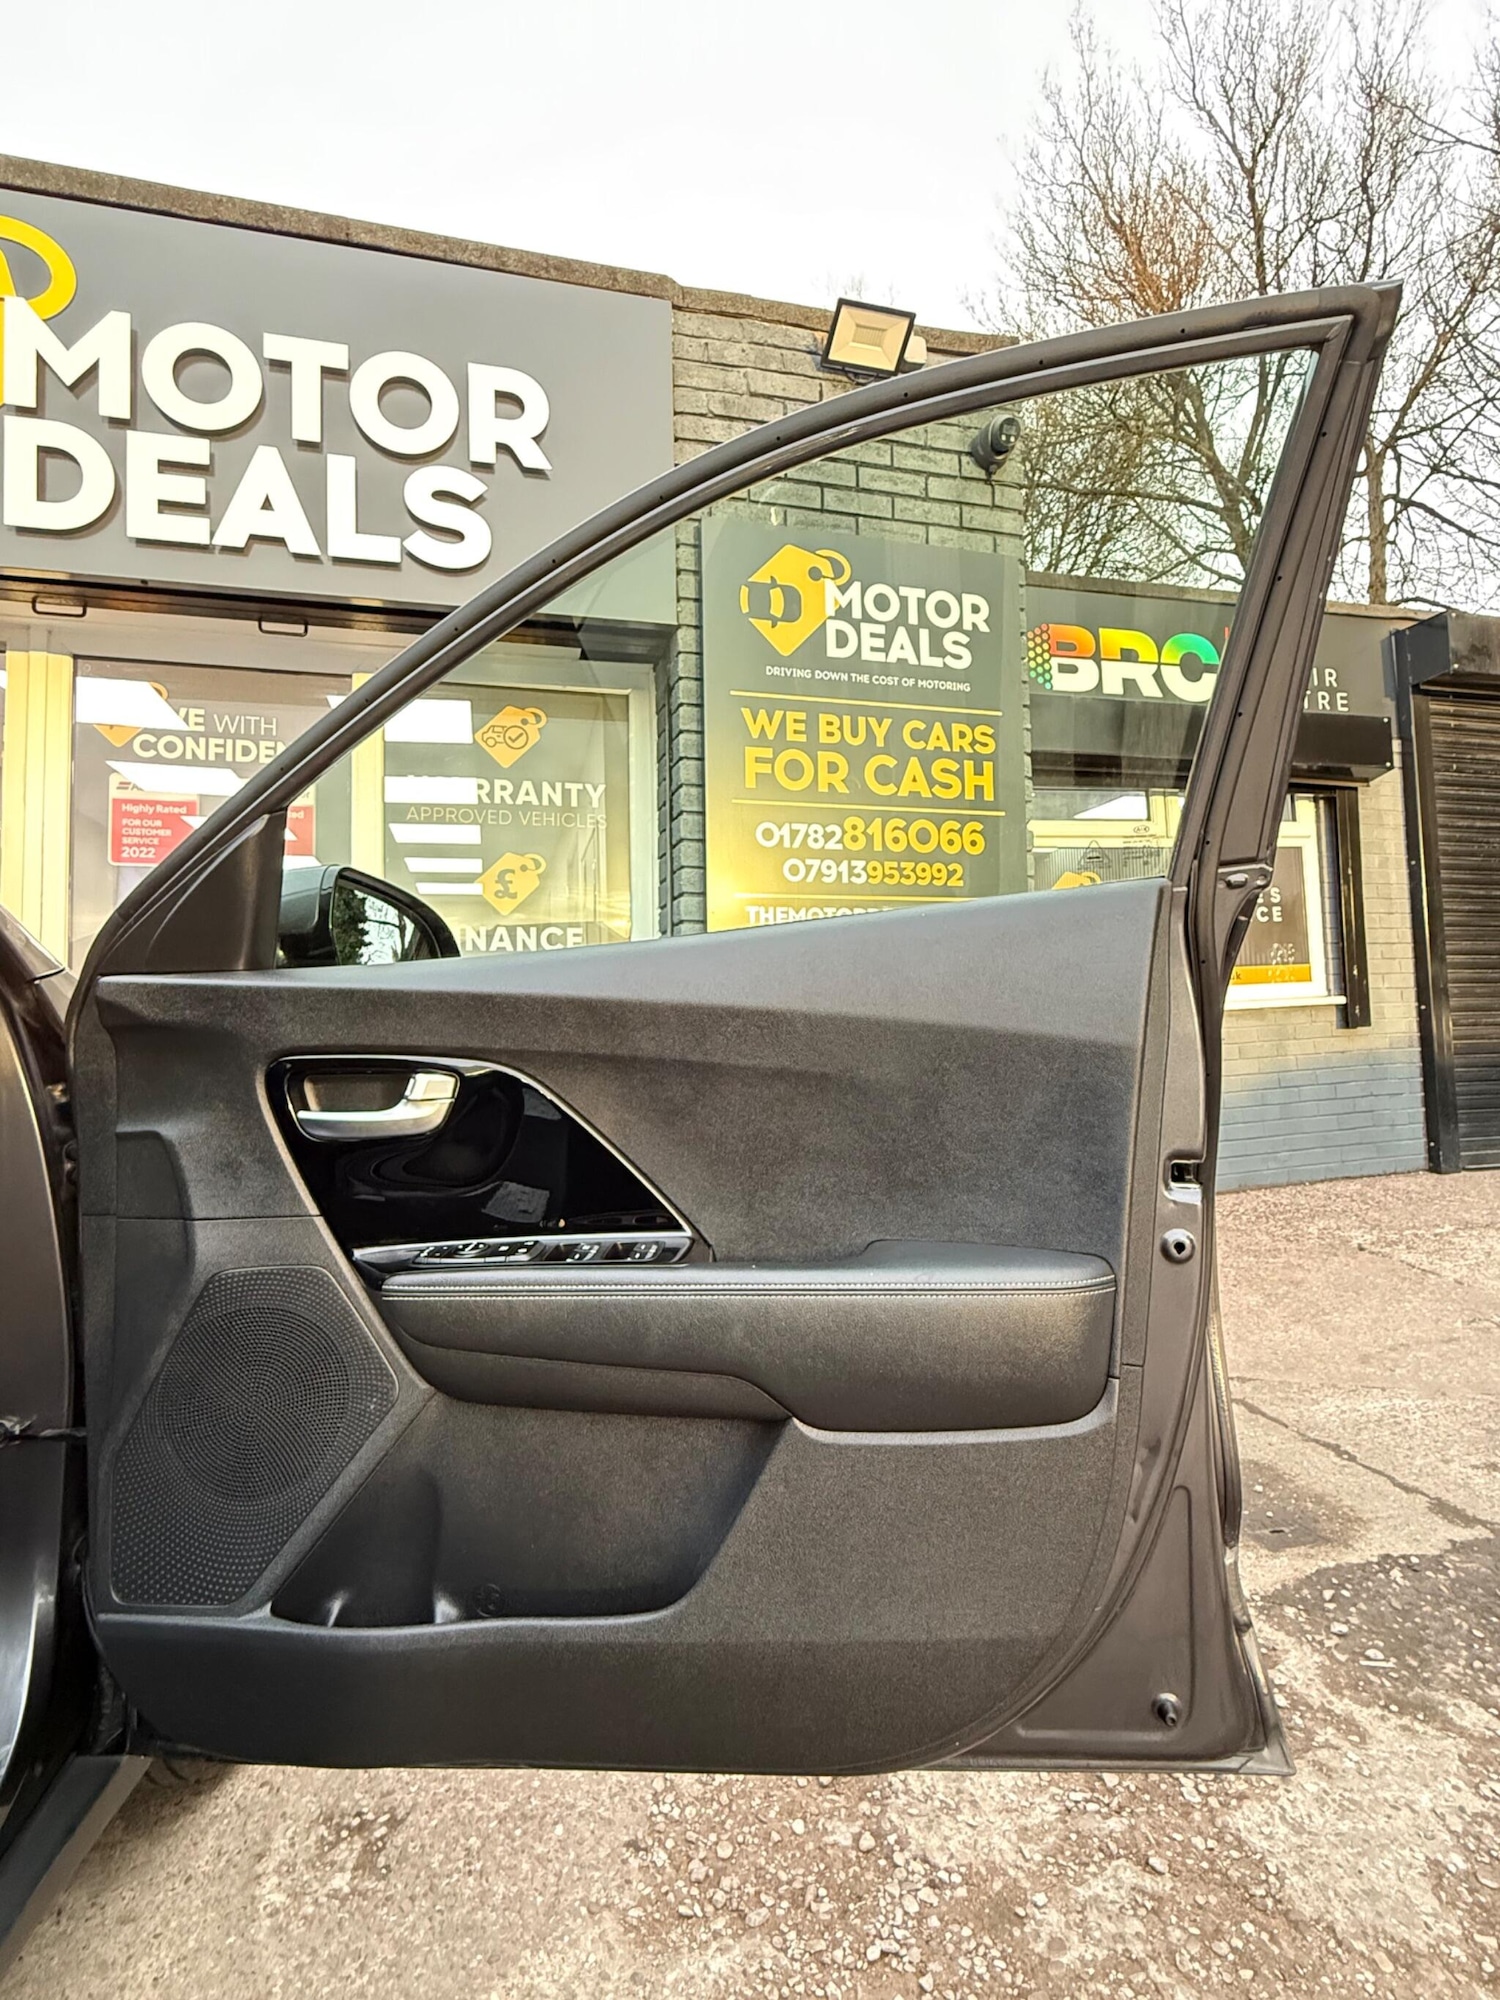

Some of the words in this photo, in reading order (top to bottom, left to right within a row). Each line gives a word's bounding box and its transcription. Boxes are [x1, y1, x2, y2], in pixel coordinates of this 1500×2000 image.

[3, 296, 552, 471] MOTOR
[3, 415, 493, 571] DEALS
[824, 578, 990, 633] MOTOR
[825, 619, 973, 670] DEALS
[765, 665, 812, 679] DRIVING
[814, 669, 849, 682] DOWN
[850, 673, 870, 684] THE
[872, 675, 899, 687] COST
[901, 678, 916, 688] OF
[917, 679, 971, 693] MOTORING
[1312, 667, 1338, 688] IR
[1303, 690, 1349, 712] TRE
[213, 714, 277, 736] WITH
[741, 708, 807, 743] WE
[818, 713, 893, 747] BUY
[902, 719, 997, 755] CARS
[744, 746, 850, 794] FOR
[863, 754, 995, 802] CASH
[121, 803, 154, 814] Highly
[155, 804, 187, 815] Rated
[406, 806, 513, 826] APPROVED
[518, 810, 608, 830] VEHICLES
[121, 818, 140, 828] FOR
[141, 819, 162, 828] OUR
[121, 828, 172, 837] CUSTOMER
[755, 816, 986, 855] 01782816066
[121, 837, 160, 846] SERVICE
[121, 846, 156, 859] 2022
[782, 858, 964, 887] 07913953992
[1256, 905, 1283, 923] CE
[456, 925, 584, 952] NANCE
